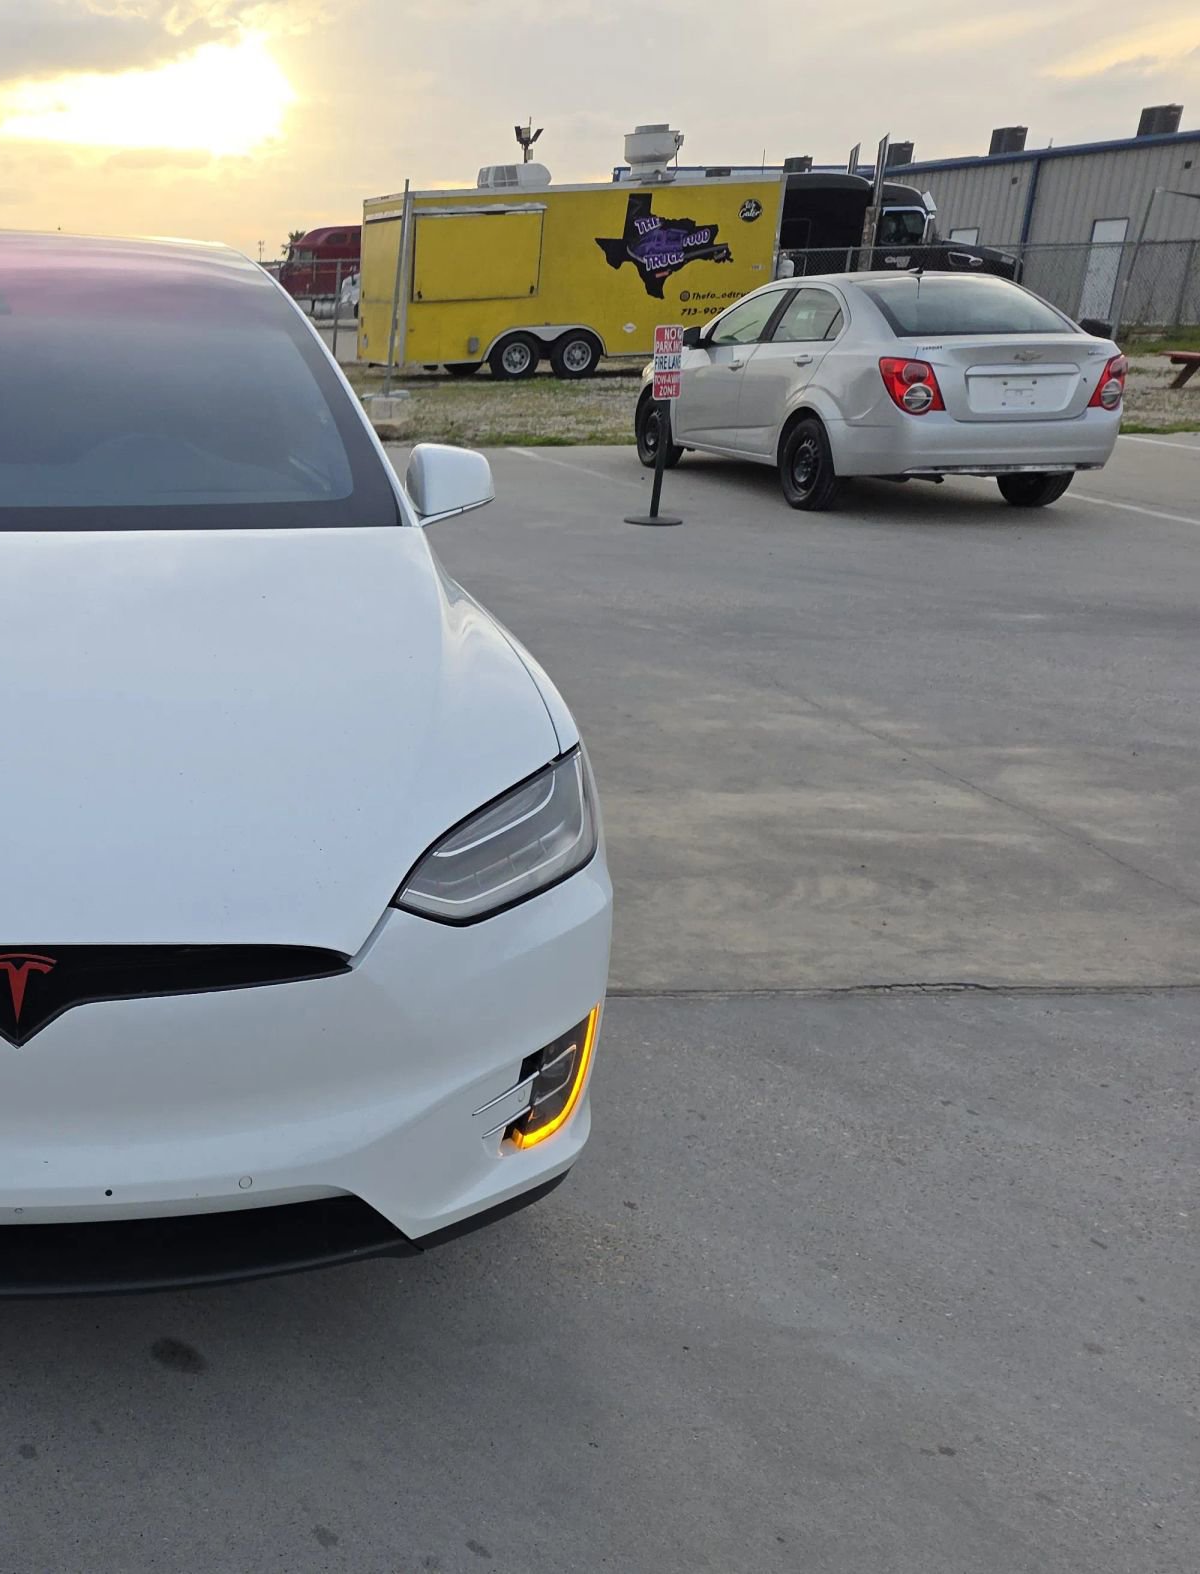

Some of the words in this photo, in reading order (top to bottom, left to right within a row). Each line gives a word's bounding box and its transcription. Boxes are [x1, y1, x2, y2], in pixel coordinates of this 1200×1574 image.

[643, 252, 685, 271] TRUCK
[655, 355, 668, 370] FIRE
[659, 385, 677, 396] ZONE
